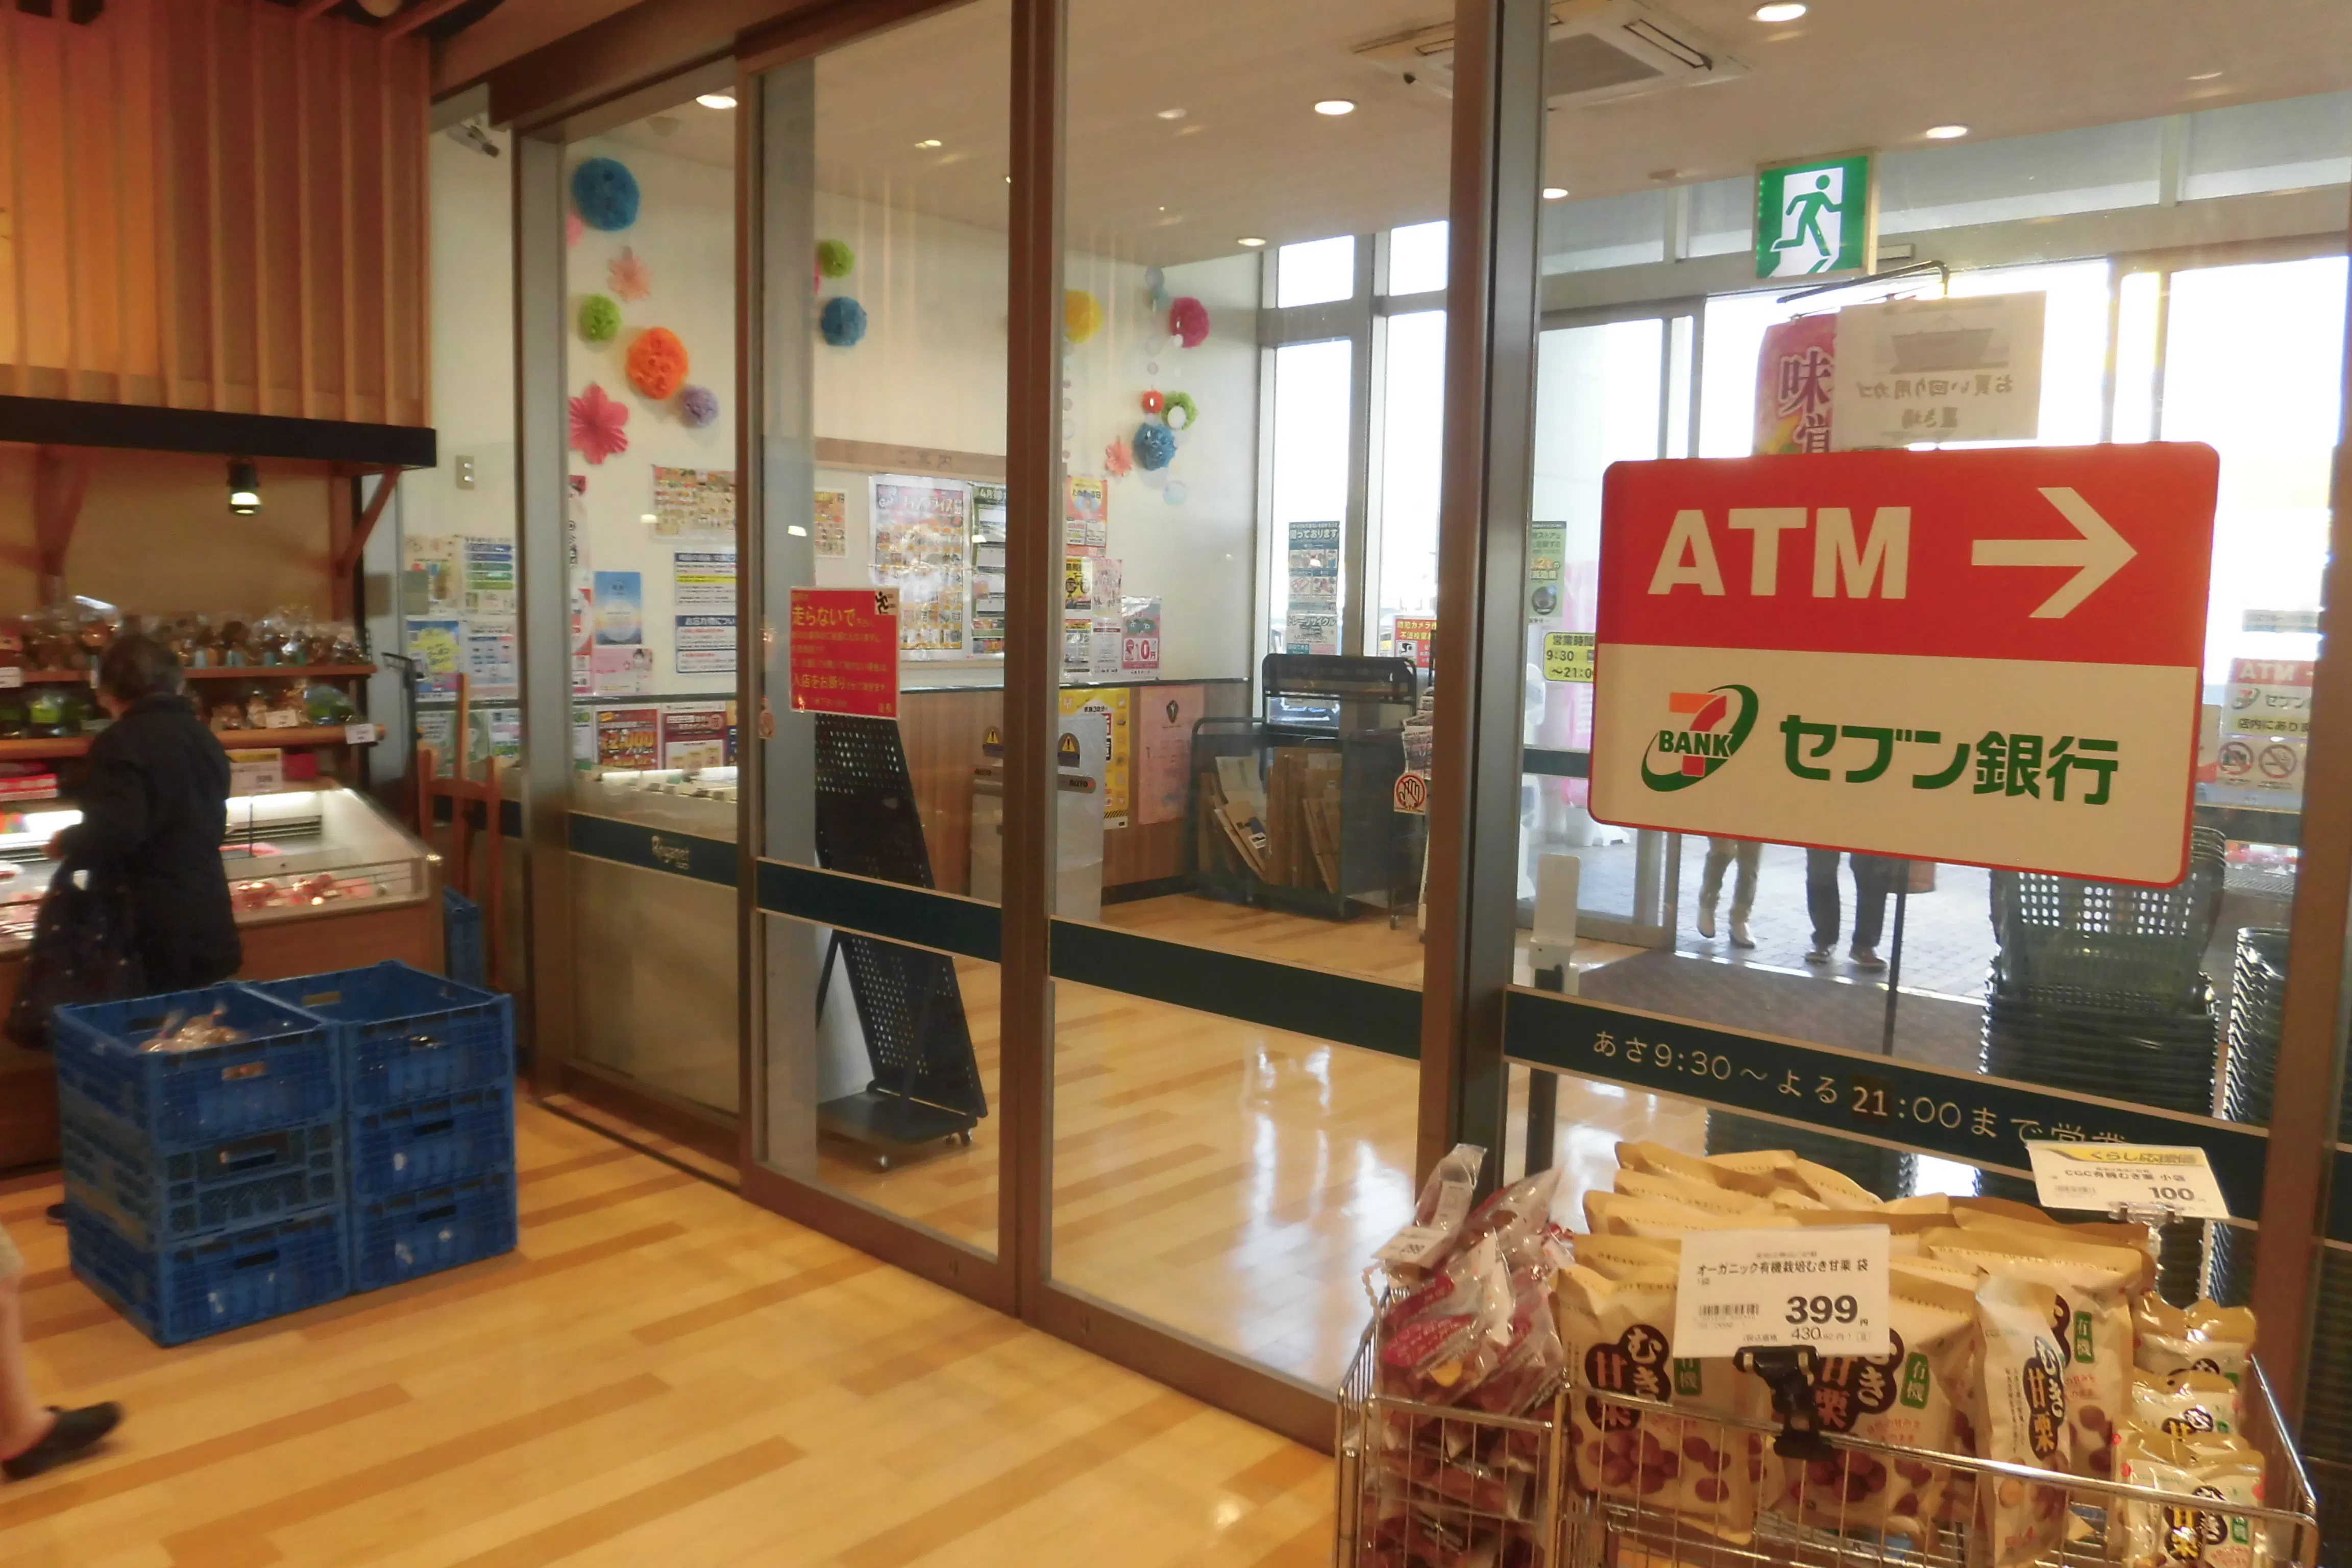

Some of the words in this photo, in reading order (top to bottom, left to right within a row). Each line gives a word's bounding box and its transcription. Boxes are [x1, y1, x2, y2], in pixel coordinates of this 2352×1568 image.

[1648, 506, 1912, 600] ATM
[1546, 650, 1575, 662] 9:30
[2239, 662, 2295, 681] ATM
[1659, 729, 1731, 757] BANK
[1780, 714, 2119, 806] セブン銀行
[2148, 1186, 2195, 1201] 100
[1785, 1294, 1858, 1325] 399
